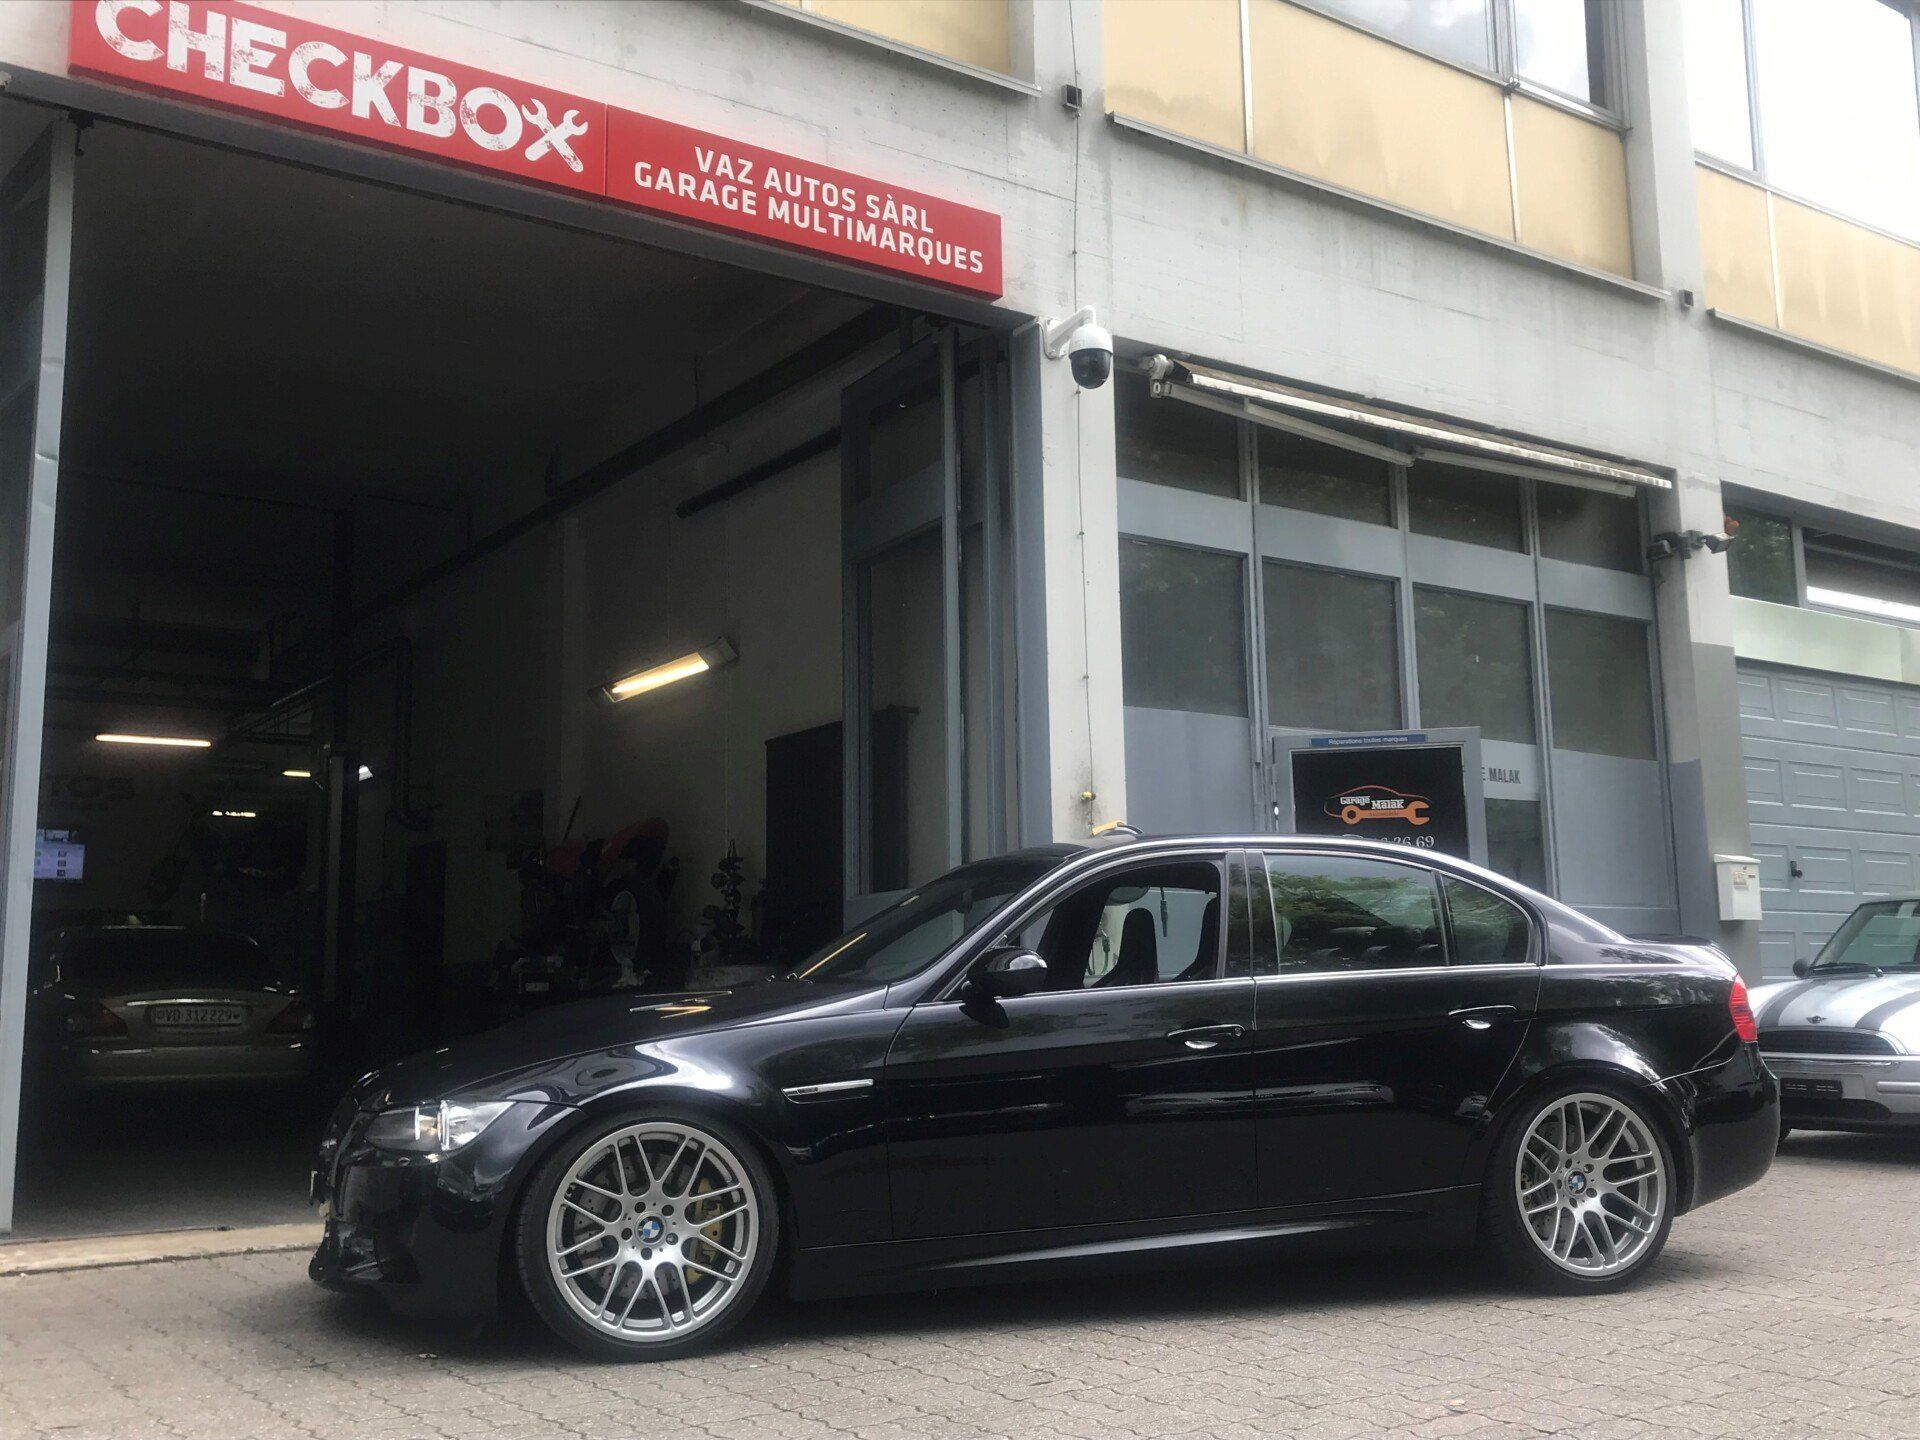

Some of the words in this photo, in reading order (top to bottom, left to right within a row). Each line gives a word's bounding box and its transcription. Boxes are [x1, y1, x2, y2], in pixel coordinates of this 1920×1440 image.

[694, 145, 754, 184] VAZ
[763, 166, 856, 212] AUTOS
[865, 193, 934, 234] SÀRL
[634, 161, 757, 216] GARAGE
[767, 196, 983, 274] MULTIMARQUES
[1488, 768, 1521, 784] MALAK
[1340, 796, 1370, 806] Garage
[1371, 800, 1404, 810] Malak
